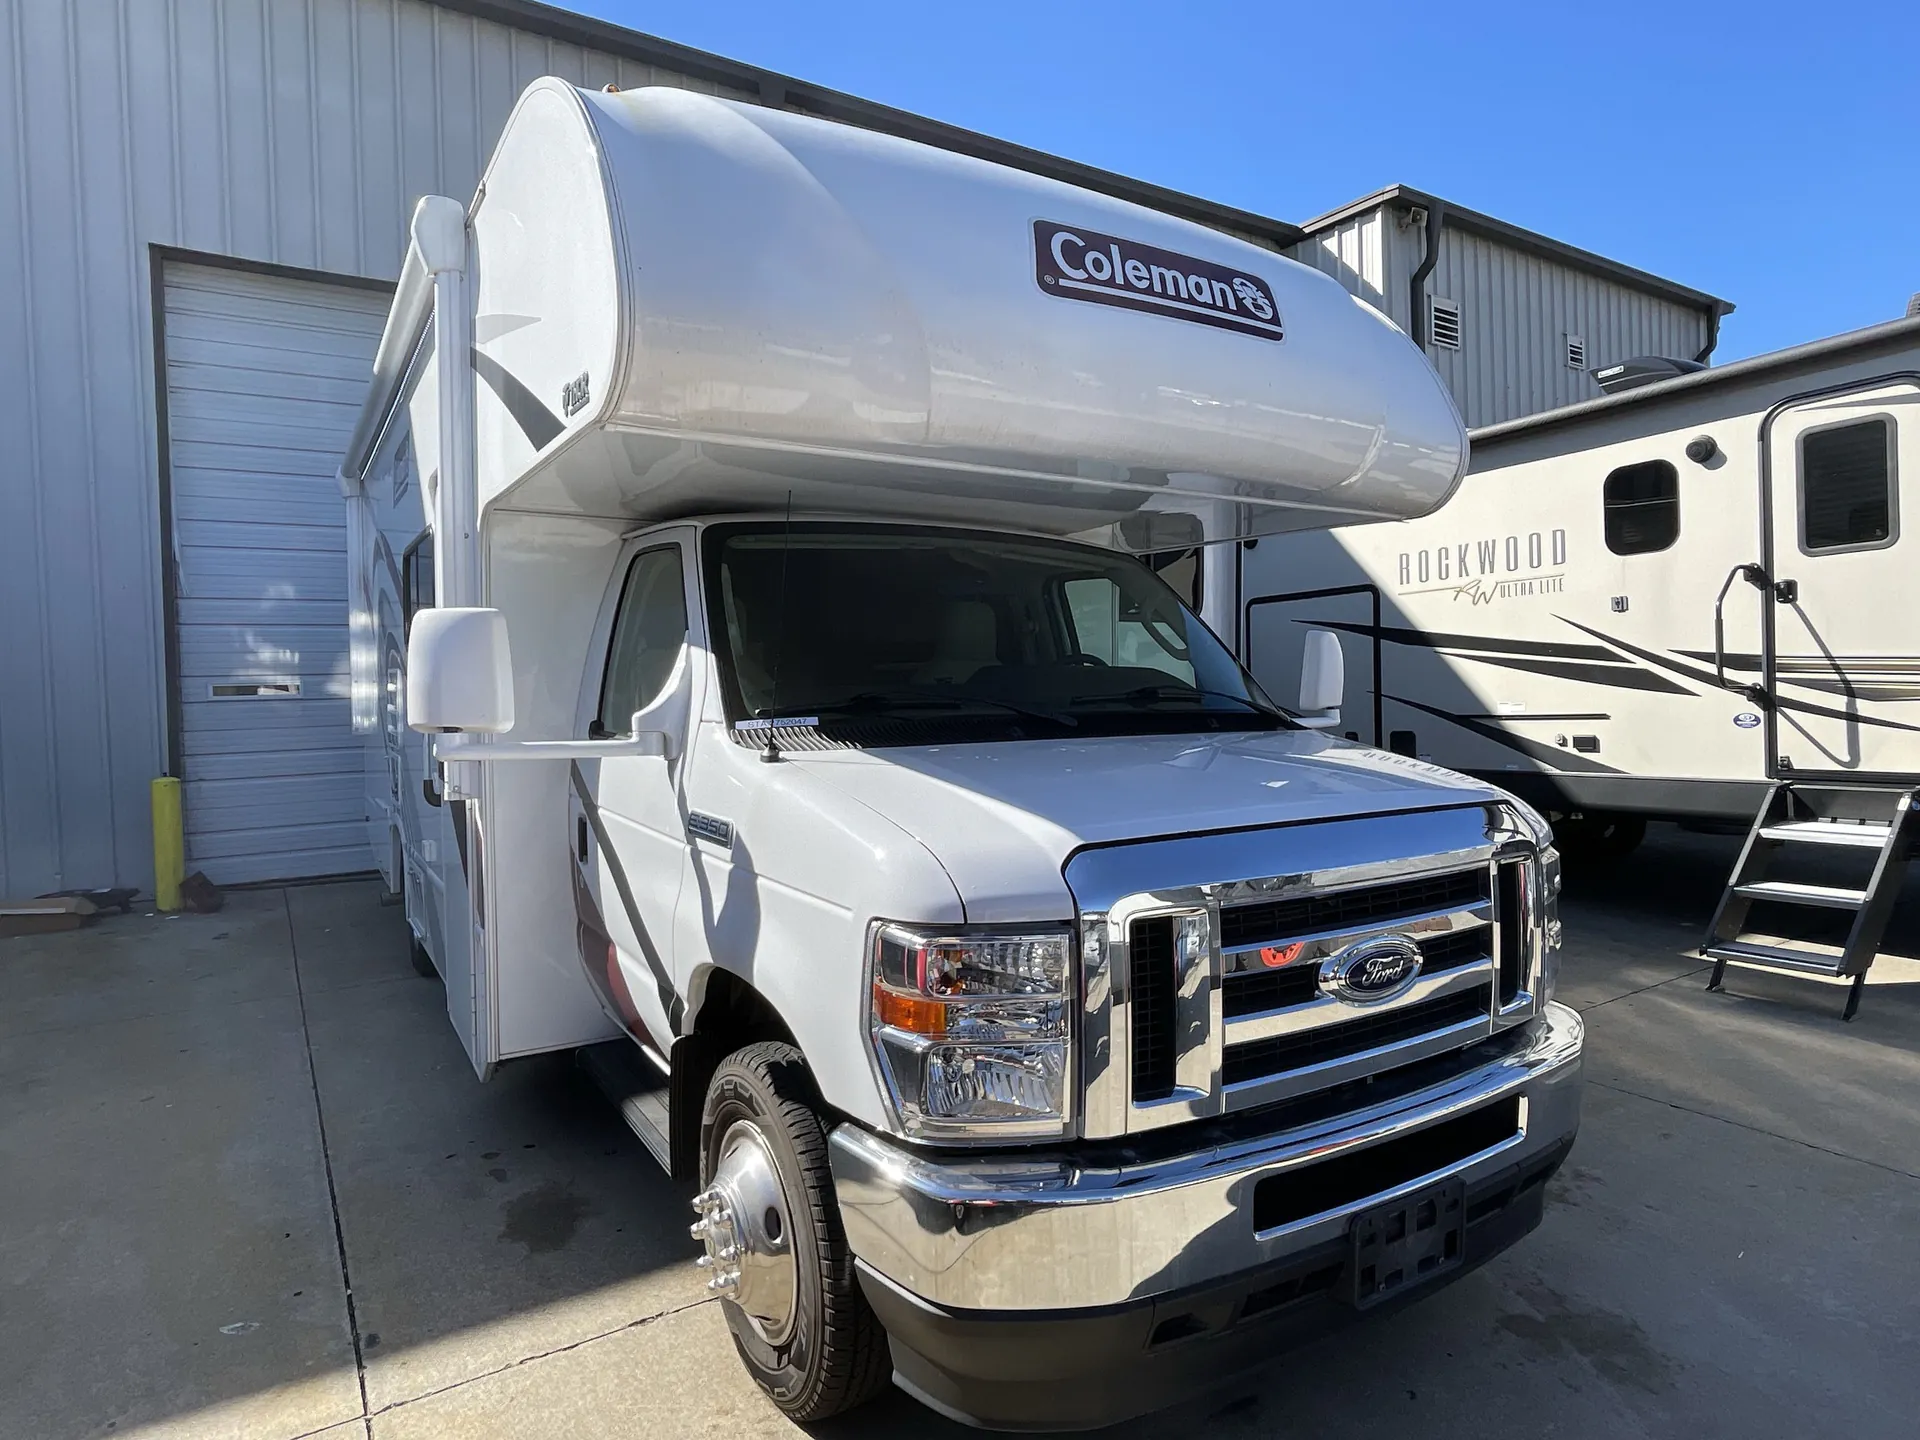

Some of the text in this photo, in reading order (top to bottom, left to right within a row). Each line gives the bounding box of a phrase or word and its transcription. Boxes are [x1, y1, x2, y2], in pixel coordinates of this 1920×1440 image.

[1050, 231, 1238, 311] Coleman
[1399, 529, 1567, 585] ROCKWOOD
[1500, 581, 1534, 598] ULTRA
[1539, 578, 1564, 595] LITE
[1362, 956, 1404, 987] Ford
